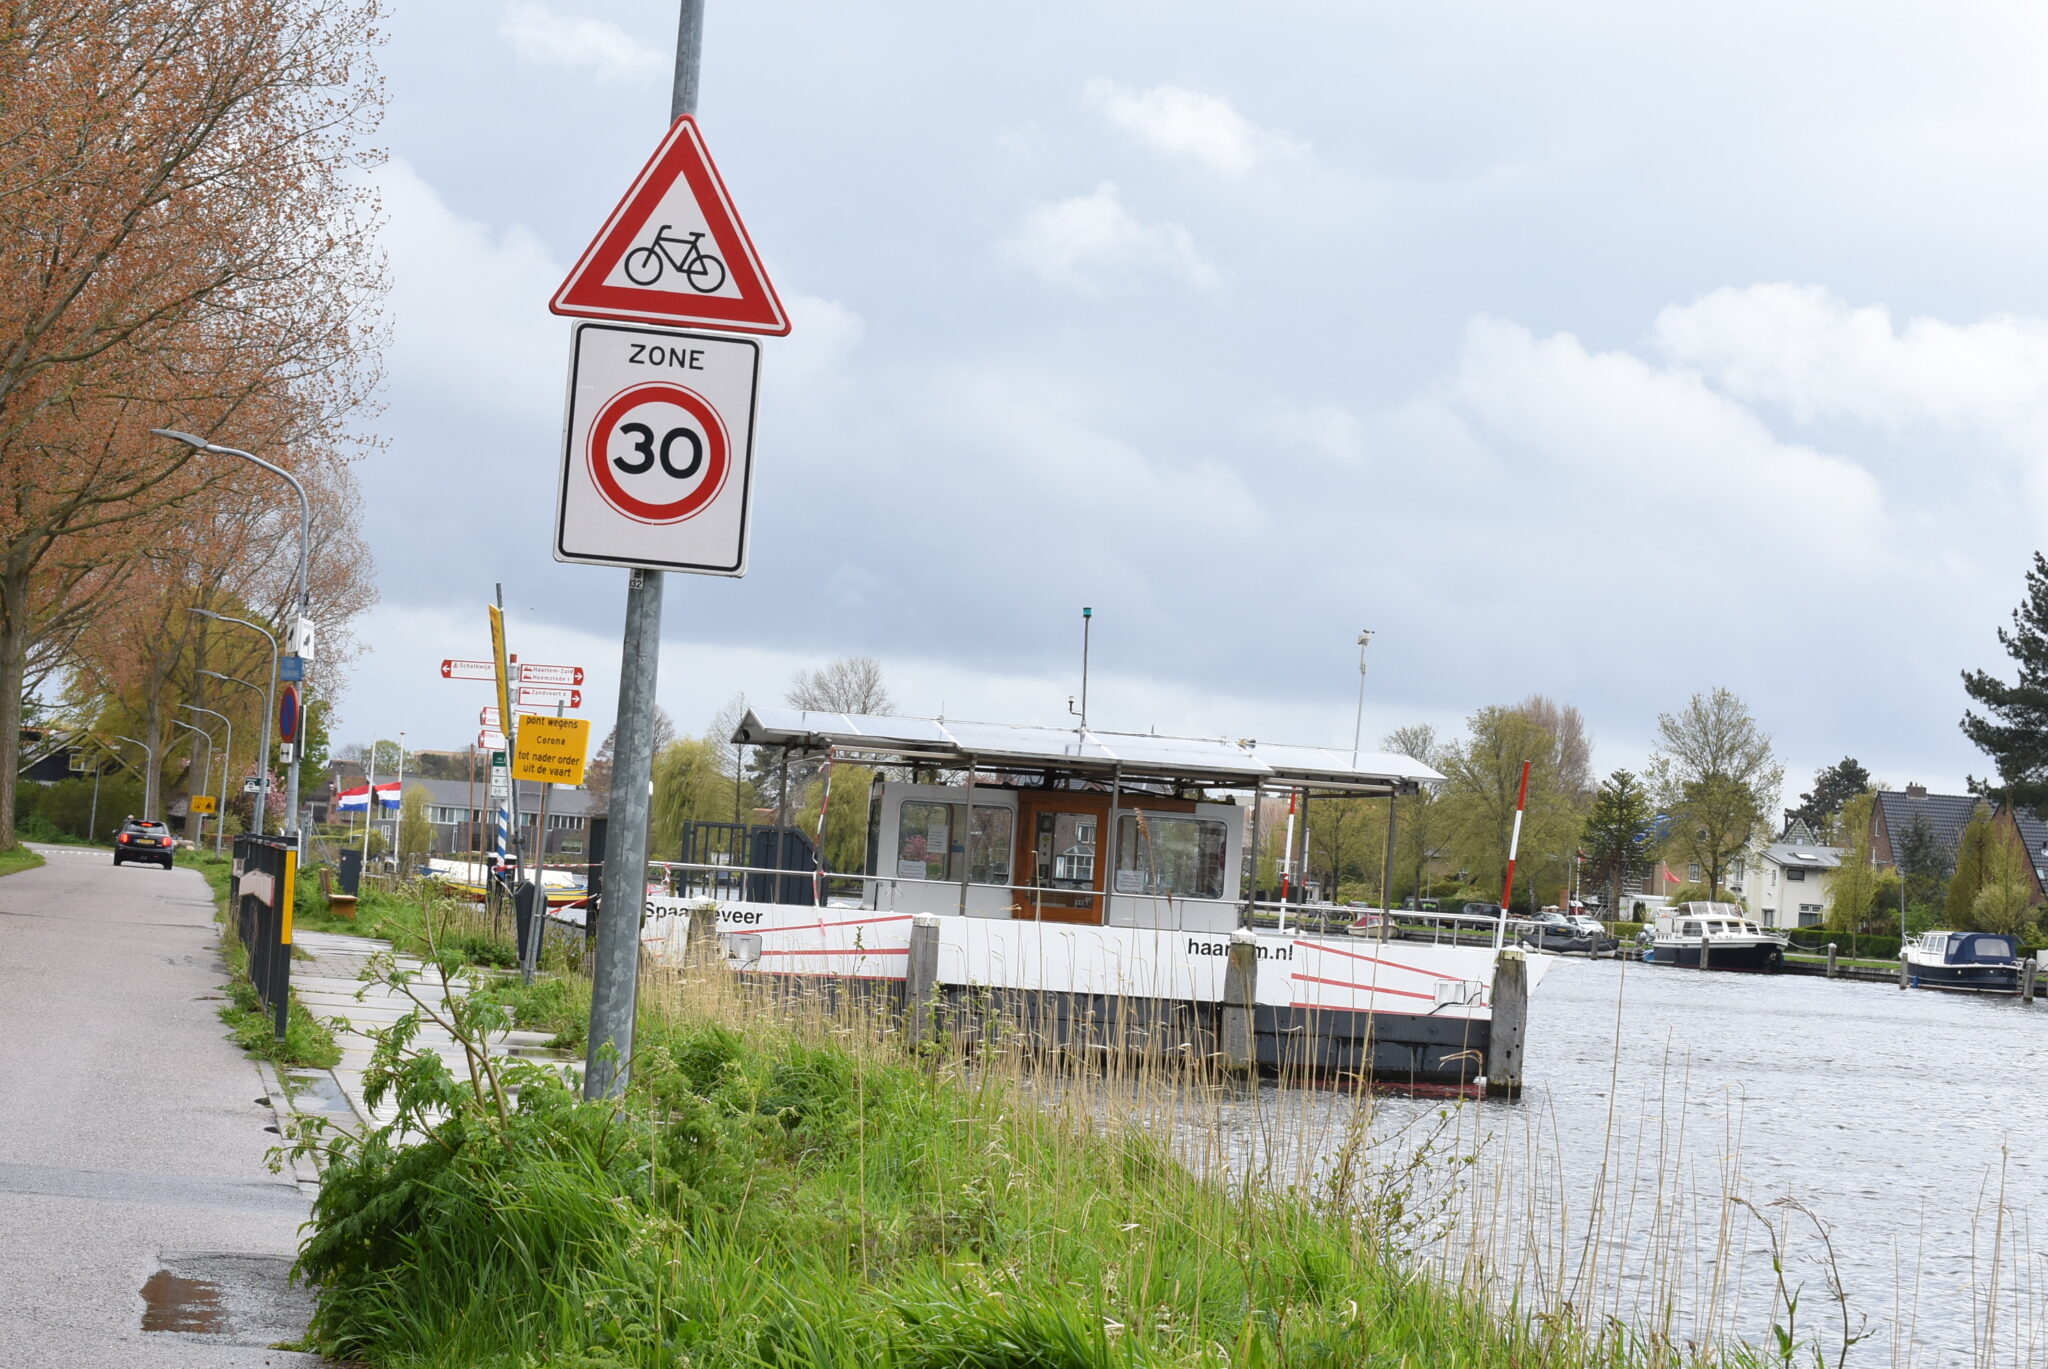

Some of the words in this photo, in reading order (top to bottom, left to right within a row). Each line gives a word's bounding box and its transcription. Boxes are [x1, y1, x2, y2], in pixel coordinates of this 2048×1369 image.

[629, 343, 705, 370] ZONE
[613, 422, 703, 480] 30
[533, 666, 574, 674] Haarlem-Zuid
[532, 674, 566, 682] Heemstede
[526, 716, 545, 726] pont
[548, 718, 579, 729] wegens
[536, 735, 566, 746] Corona
[518, 751, 530, 761] tot
[532, 753, 557, 763] nader
[557, 755, 580, 766] order
[523, 763, 535, 774] uit
[536, 764, 547, 775] de
[549, 767, 572, 777] vaart
[1187, 937, 1293, 961] haarm.nl
